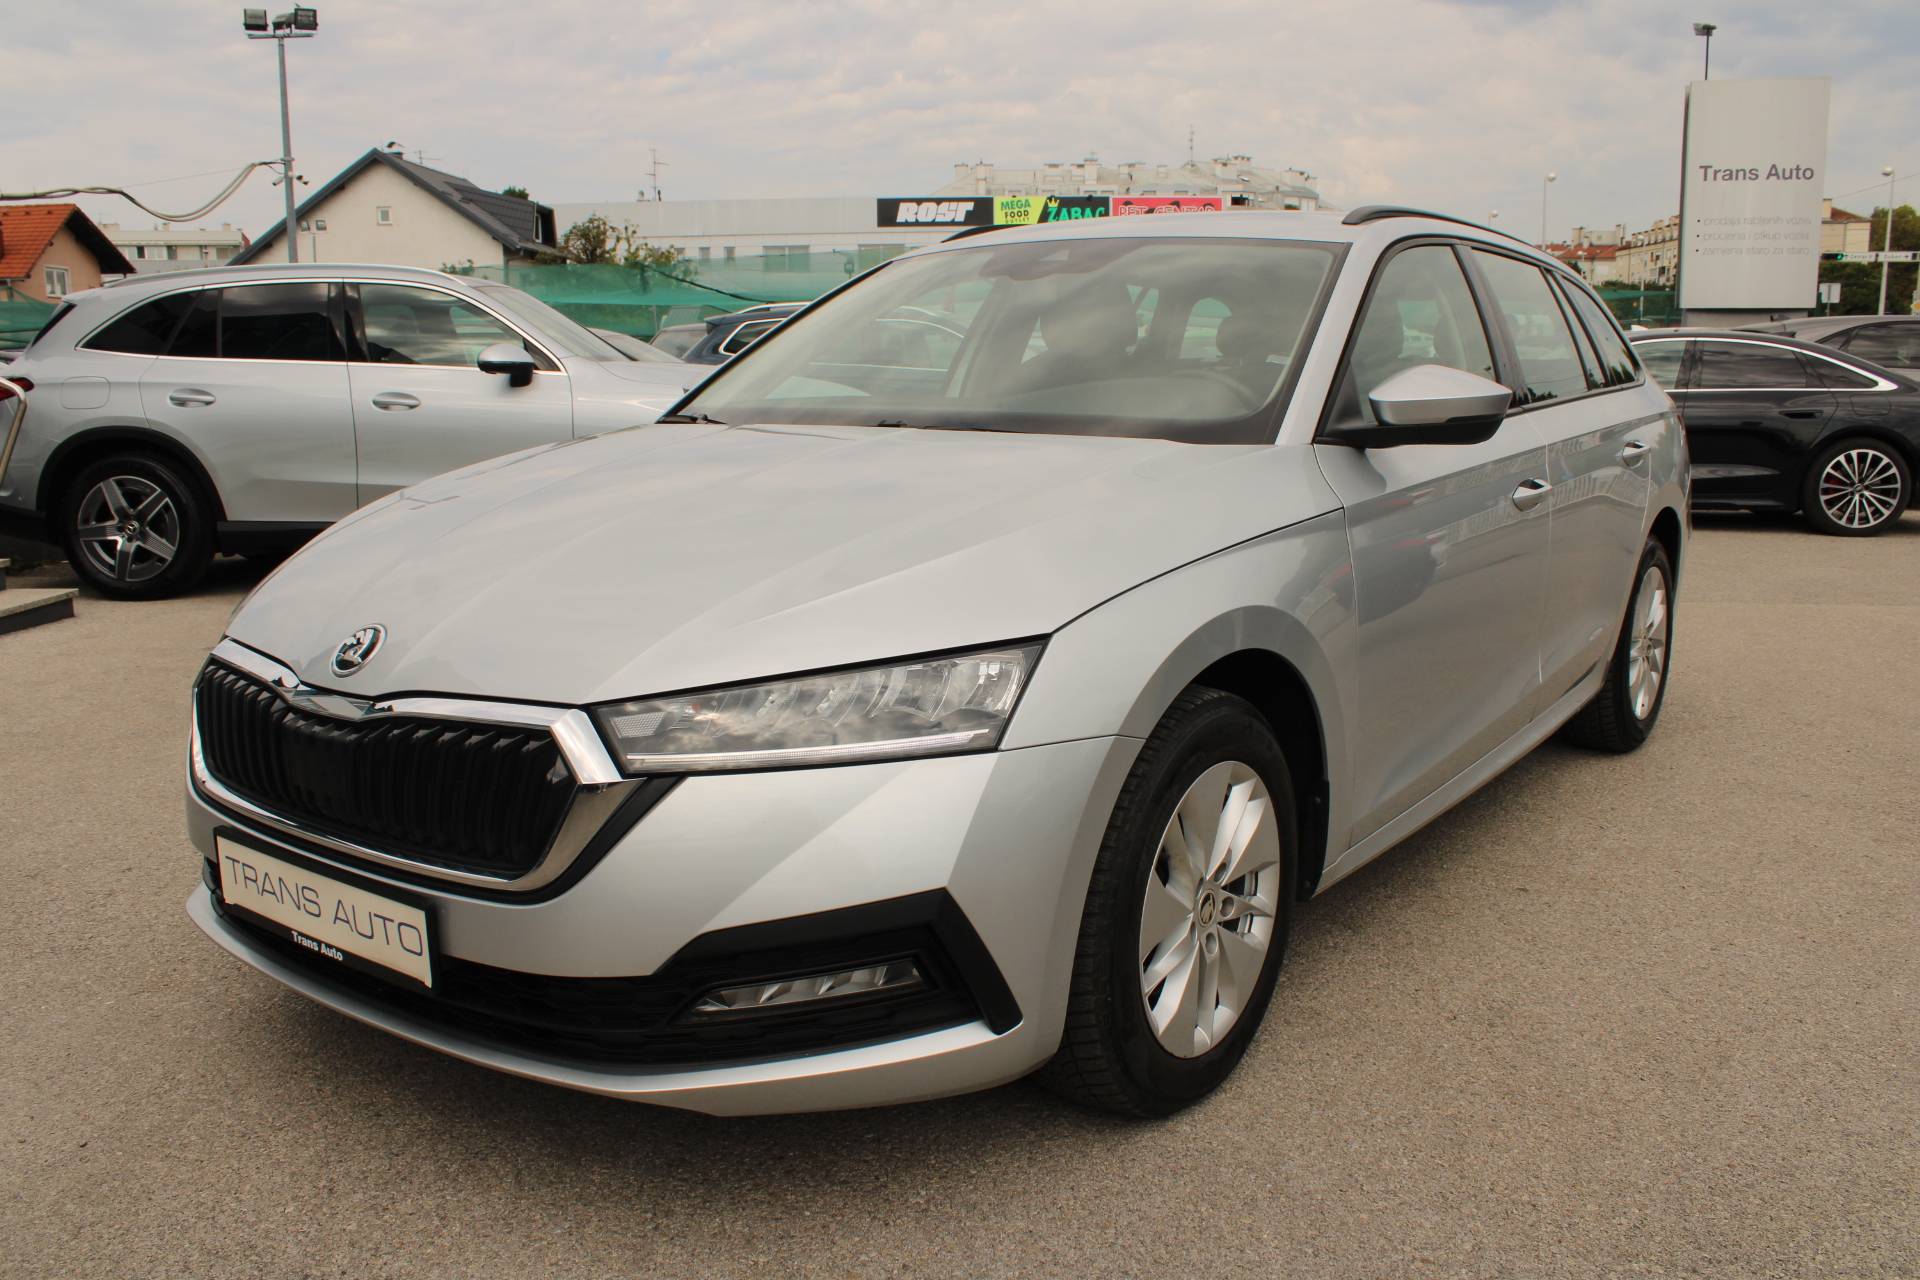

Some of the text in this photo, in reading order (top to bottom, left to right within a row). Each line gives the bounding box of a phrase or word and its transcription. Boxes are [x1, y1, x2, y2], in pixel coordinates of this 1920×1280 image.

[1699, 163, 1815, 182] Trans Auto
[896, 201, 975, 223] ROST
[1001, 199, 1031, 210] MEGA
[1005, 210, 1029, 218] FOOD
[225, 855, 423, 957] TRANS AUTO
[291, 930, 343, 961] Trans Auto
